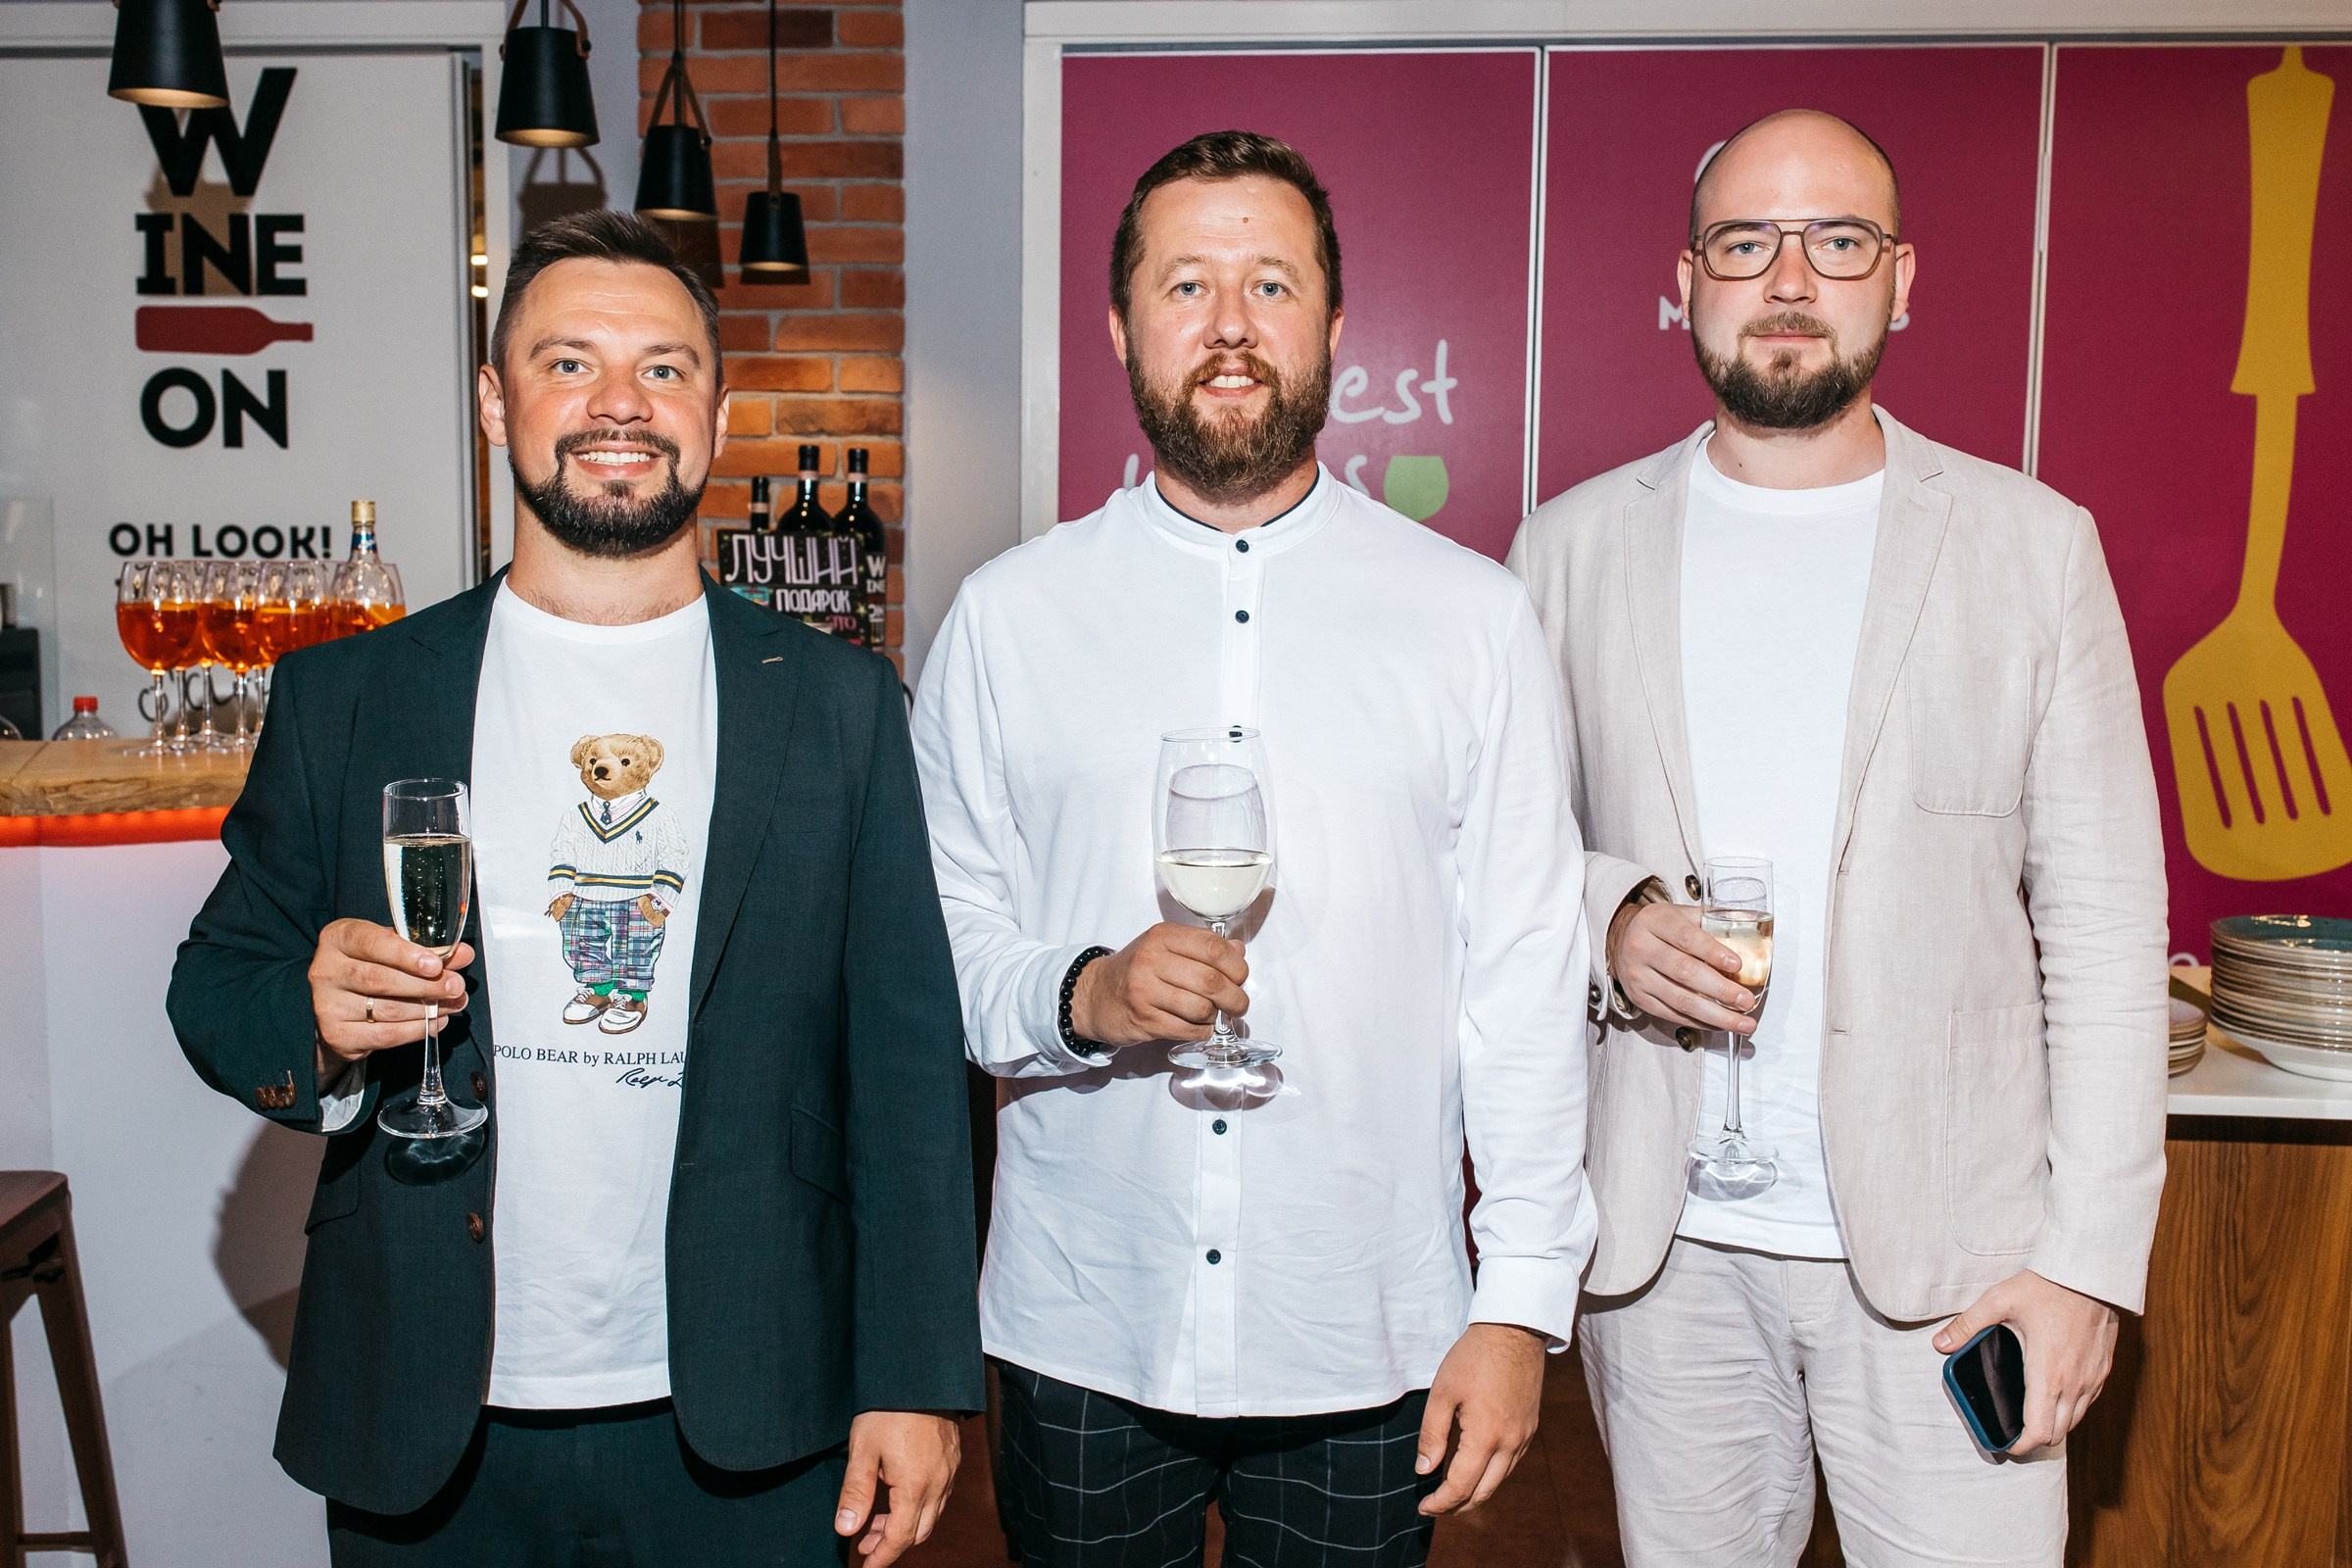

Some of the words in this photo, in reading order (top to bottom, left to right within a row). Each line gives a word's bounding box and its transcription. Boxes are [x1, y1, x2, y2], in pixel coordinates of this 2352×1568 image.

[135, 213, 307, 296] INE
[139, 367, 289, 449] ON
[109, 523, 173, 558] OH
[192, 524, 331, 560] LOOK!
[724, 534, 858, 585] ЛУЧШИЙ
[775, 588, 852, 612] ПОДАРОК
[494, 1045, 532, 1060] POLO
[536, 1048, 578, 1063] BEAR
[583, 1052, 599, 1067] by
[604, 1052, 657, 1065] RALPH
